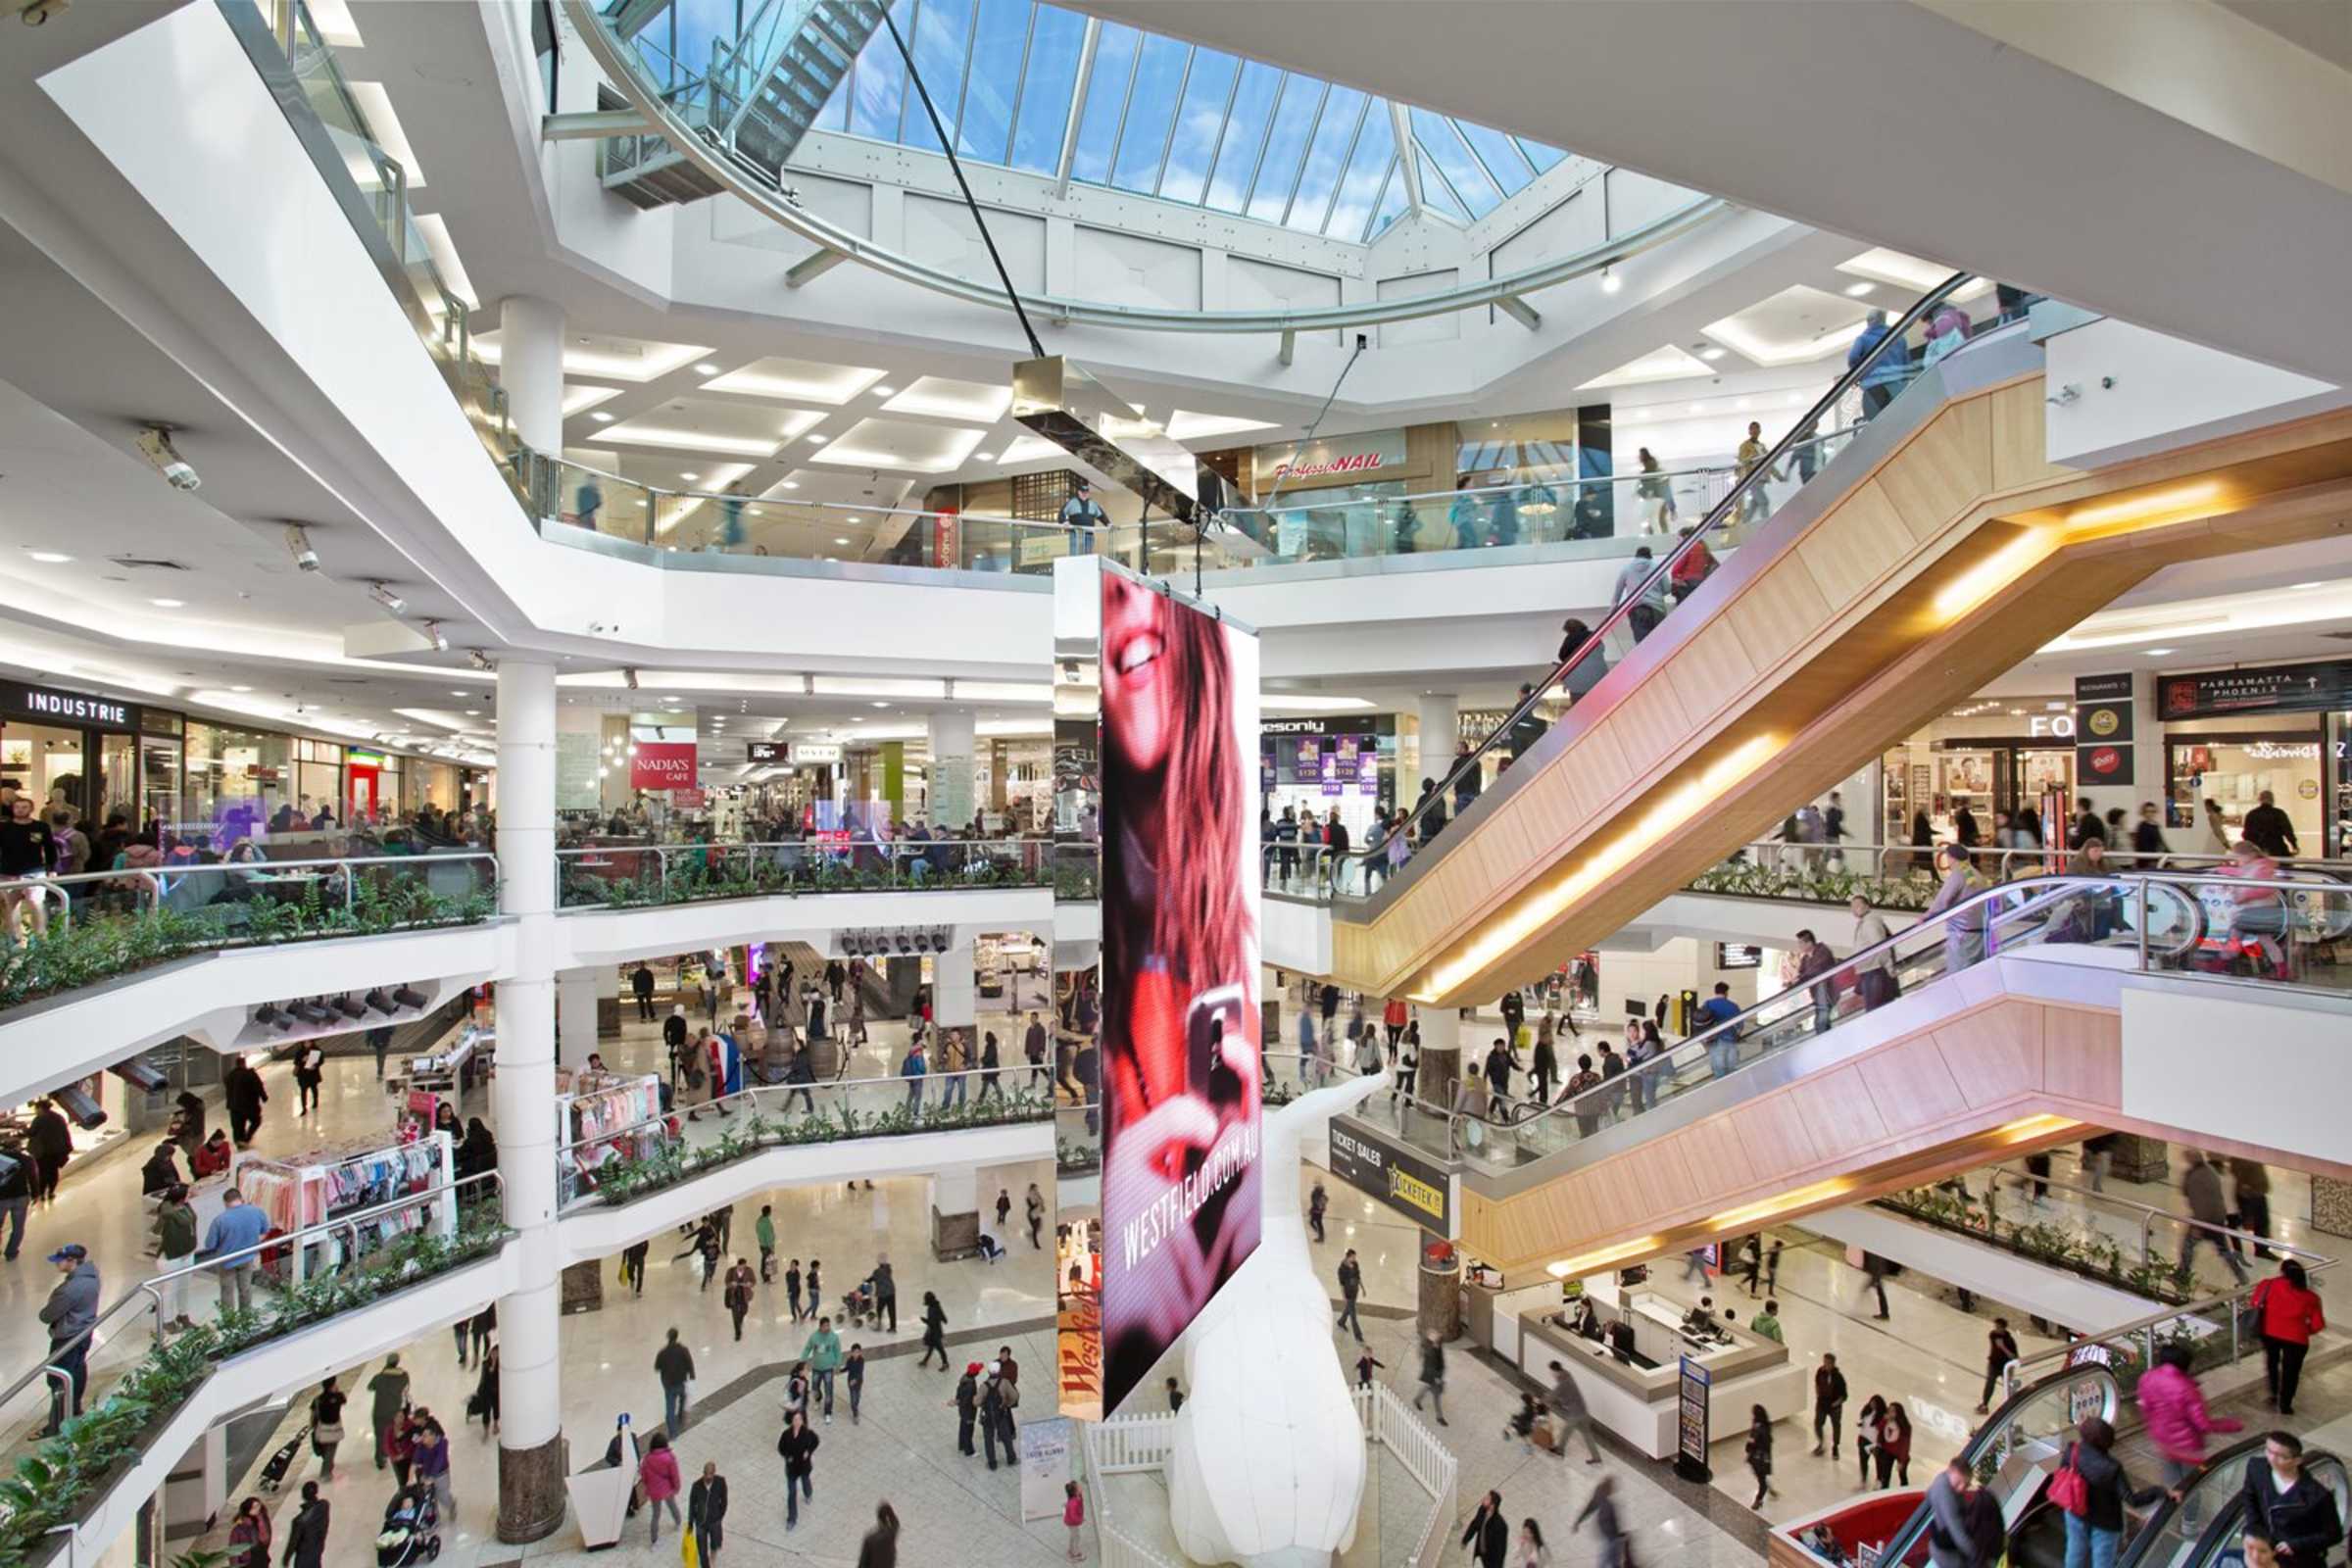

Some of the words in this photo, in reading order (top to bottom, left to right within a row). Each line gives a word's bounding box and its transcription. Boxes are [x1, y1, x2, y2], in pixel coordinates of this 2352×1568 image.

[2199, 674, 2292, 689] PARRAMATTA
[2213, 685, 2278, 697] PHOENIX
[27, 691, 125, 724] INDUSTRIE
[637, 760, 689, 771] NADIA'S
[1332, 1129, 1356, 1152] TICKET
[1356, 1142, 1382, 1167] SALES
